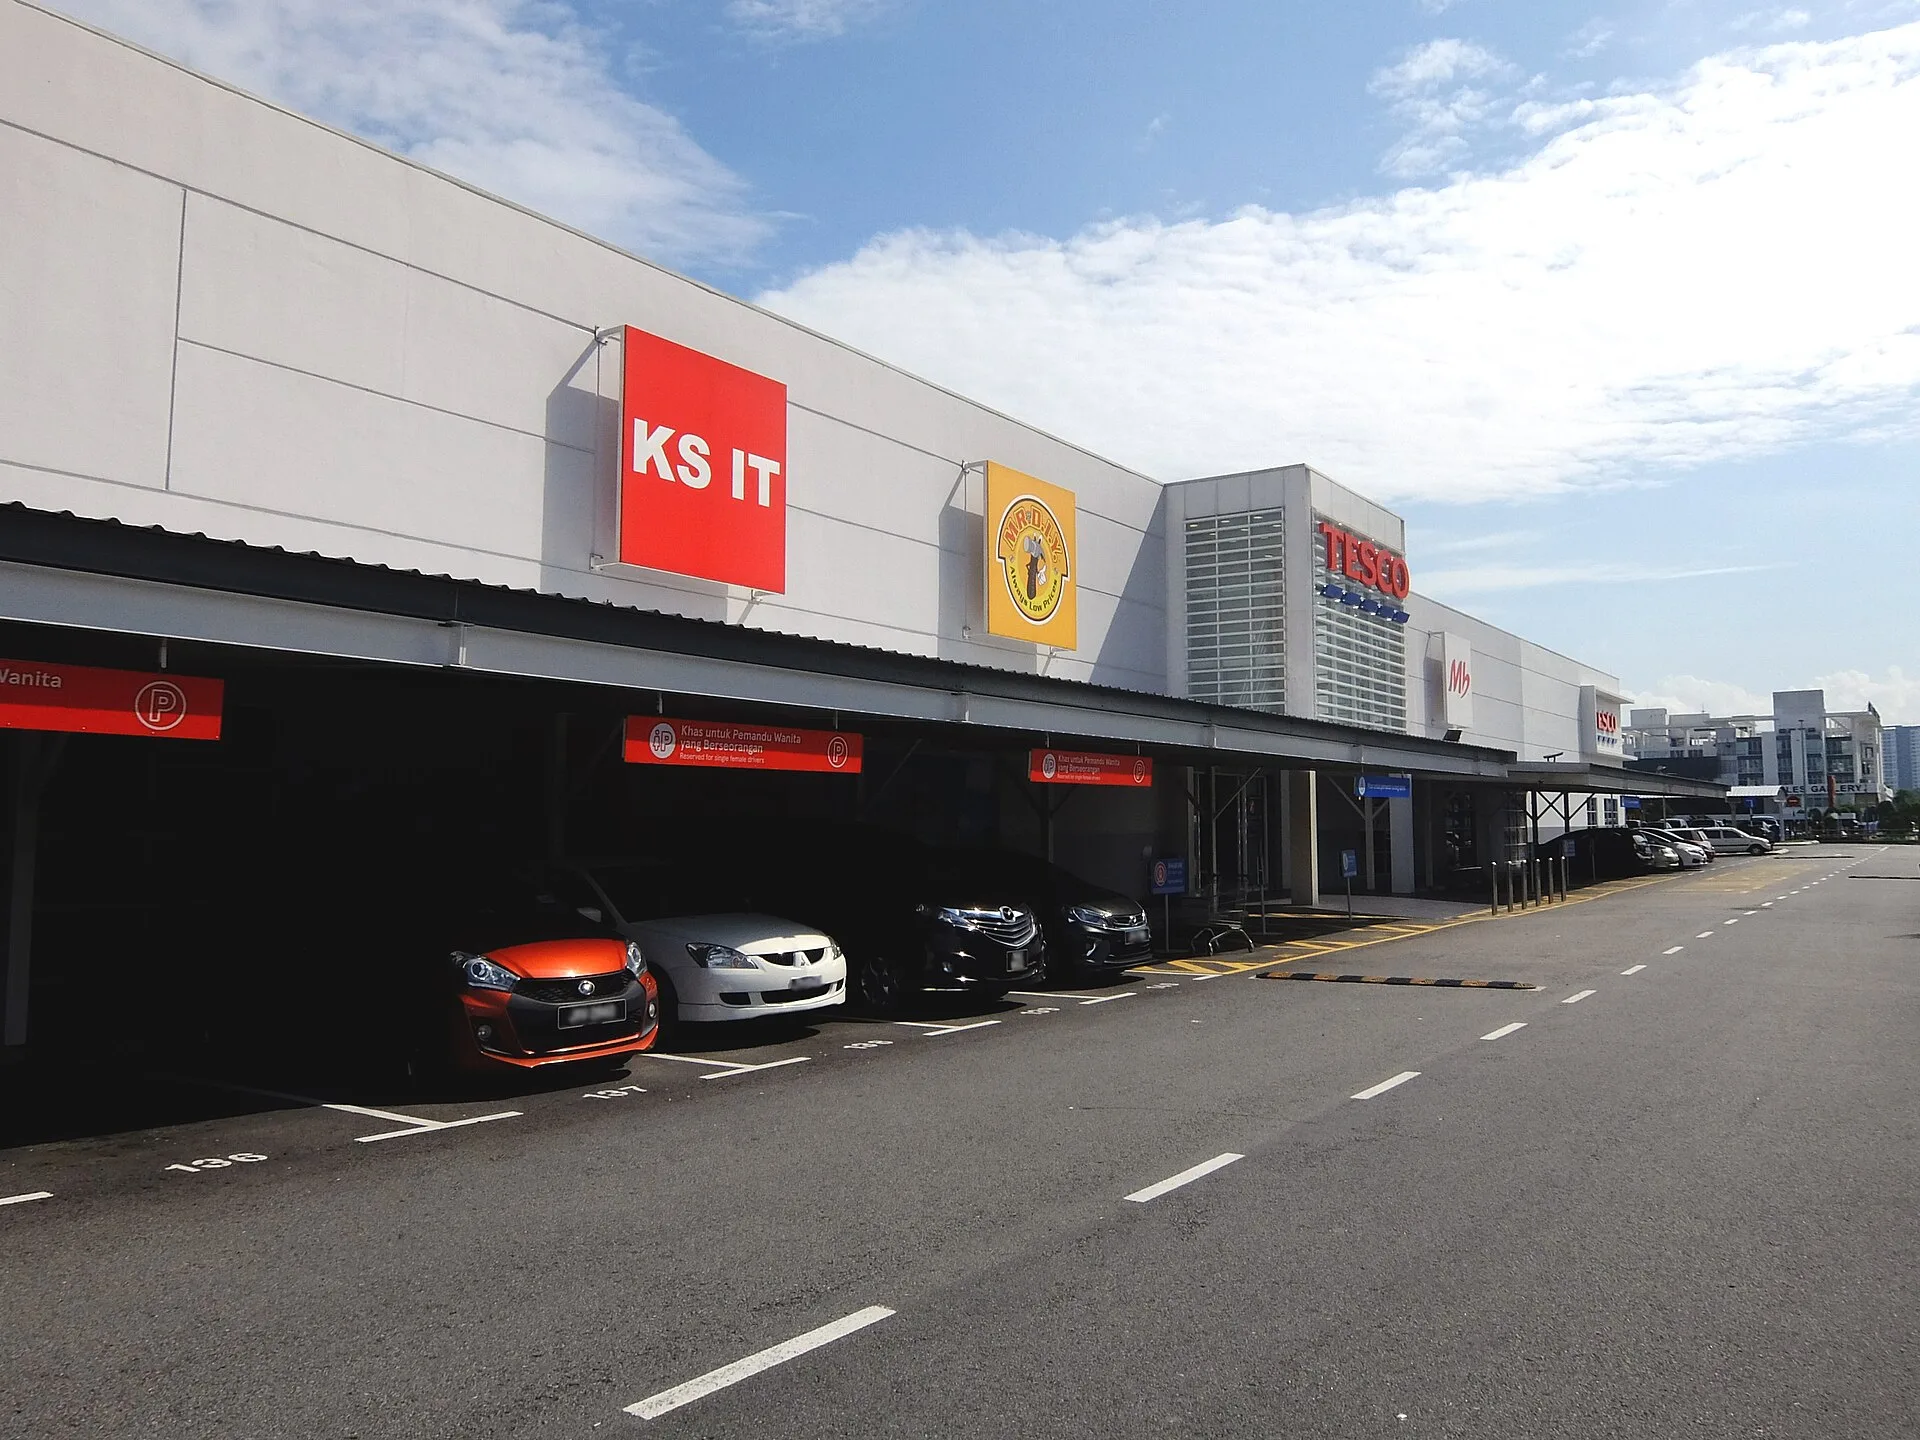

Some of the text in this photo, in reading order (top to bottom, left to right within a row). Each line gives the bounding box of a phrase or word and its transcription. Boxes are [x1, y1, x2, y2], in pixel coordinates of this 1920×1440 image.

[633, 418, 780, 508] KS IT
[1319, 522, 1410, 600] TESCO
[1009, 566, 1058, 612] Always Low Prices
[1596, 711, 1617, 732] ESCO
[681, 725, 801, 744] Khas untuk Pemandu Wanita
[680, 739, 763, 755] yang Berseorangan
[680, 752, 704, 761] Reserved
[706, 753, 714, 761] for
[730, 755, 746, 763] female
[747, 755, 764, 764] drivers
[164, 1152, 268, 1172] 136
